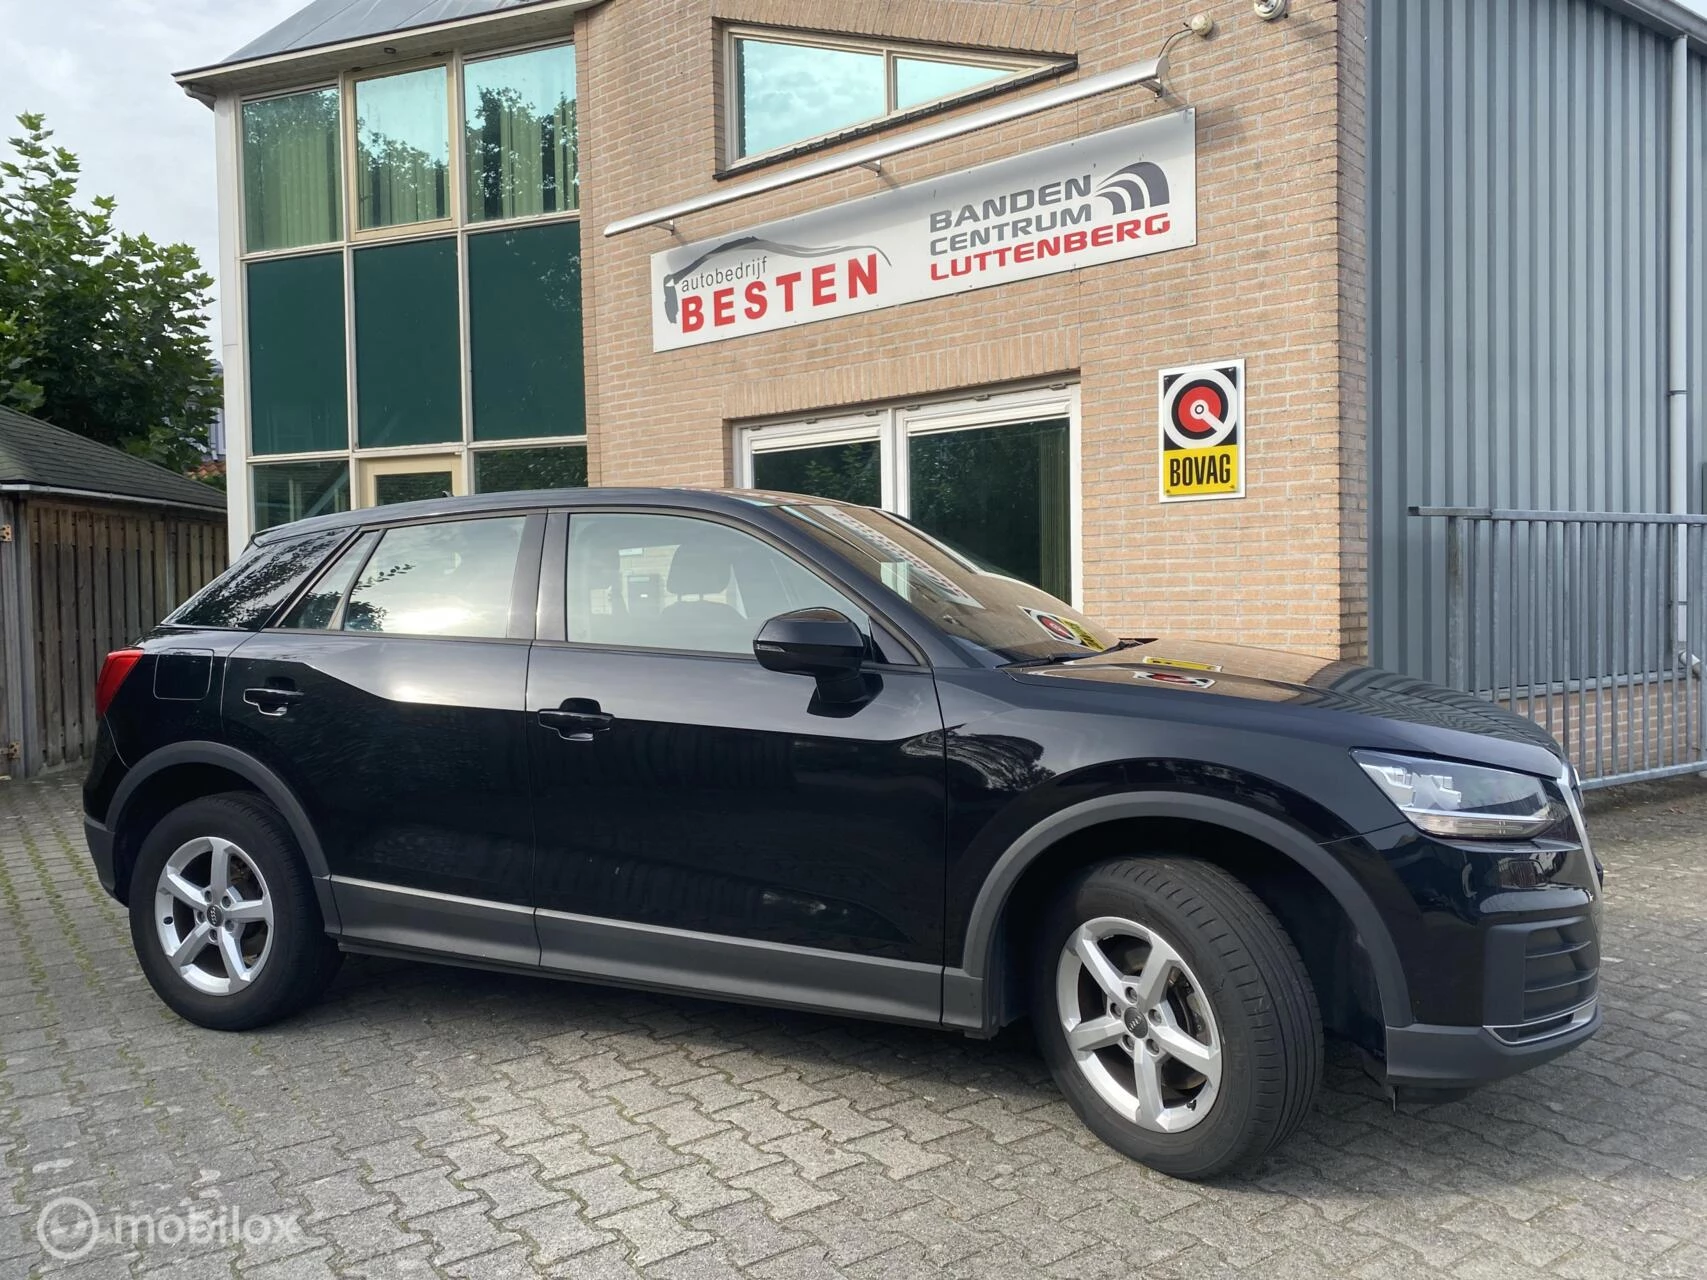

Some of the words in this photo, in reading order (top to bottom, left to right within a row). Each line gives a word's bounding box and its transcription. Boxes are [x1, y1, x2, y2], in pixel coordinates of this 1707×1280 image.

[930, 174, 1092, 233] BANDEN
[930, 203, 1092, 256] CENTRUM
[681, 256, 768, 292] autobedrijf
[930, 212, 1171, 281] LUTTENBERG
[681, 253, 878, 334] BESTEN
[1169, 453, 1231, 487] BOVAG
